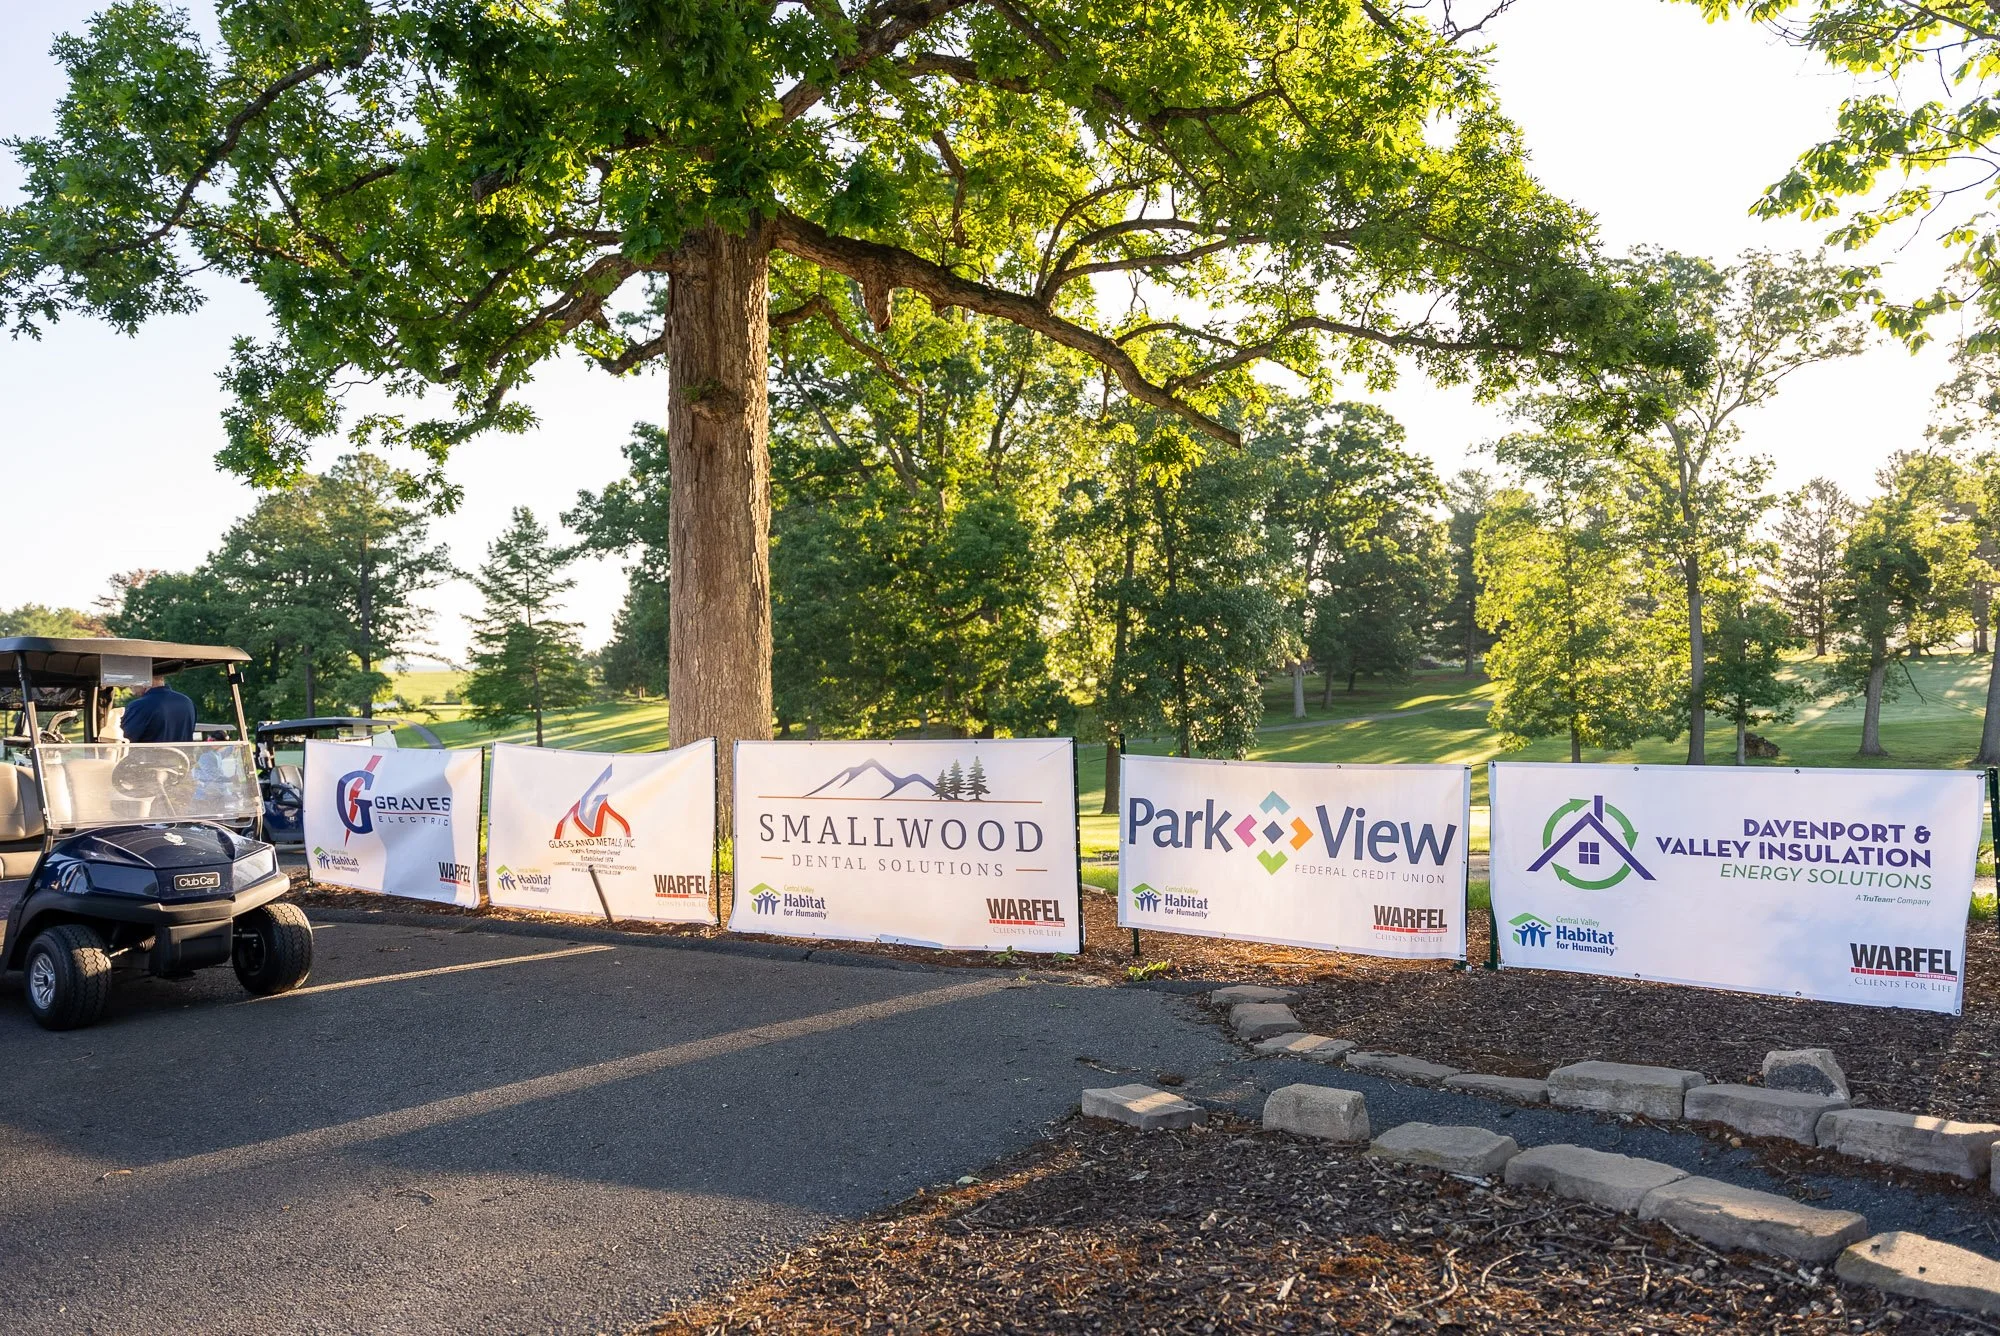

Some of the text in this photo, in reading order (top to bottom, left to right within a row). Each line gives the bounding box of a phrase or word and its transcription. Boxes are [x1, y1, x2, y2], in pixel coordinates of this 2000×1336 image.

[374, 796, 451, 812] GRAVES
[378, 816, 449, 827] ELECTRIC
[759, 813, 1043, 853] SMALLWOOD
[1128, 797, 1458, 866] Park View
[1743, 818, 1931, 844] DAVENPORT &
[548, 840, 575, 848] GLASS
[576, 839, 595, 847] AND
[624, 839, 636, 848] INC.
[1655, 836, 1931, 869] VALLEY INSULATION
[331, 855, 359, 866] Habitat
[792, 854, 1003, 877] DENTAL SOLUTIONS
[438, 861, 470, 883] WARFEL
[517, 874, 551, 885] Habitat
[1295, 864, 1445, 885] FEDERAL CREDIT UNION
[1720, 863, 1932, 890] ENERGY SOLUTIONS
[179, 876, 215, 887] Club Car
[653, 874, 707, 894] WARFEL
[784, 894, 826, 909] Habitat
[986, 898, 1065, 922] WARFEL
[1165, 894, 1208, 910] Habitat
[1896, 896, 1931, 906] Company
[783, 908, 793, 916] for
[1165, 907, 1174, 915] for
[1374, 905, 1447, 928] WARFEL
[1555, 915, 1600, 928] Central Valley
[1556, 925, 1614, 945] Habitat
[1556, 941, 1569, 950] for
[1850, 943, 1957, 976] WARFEL
